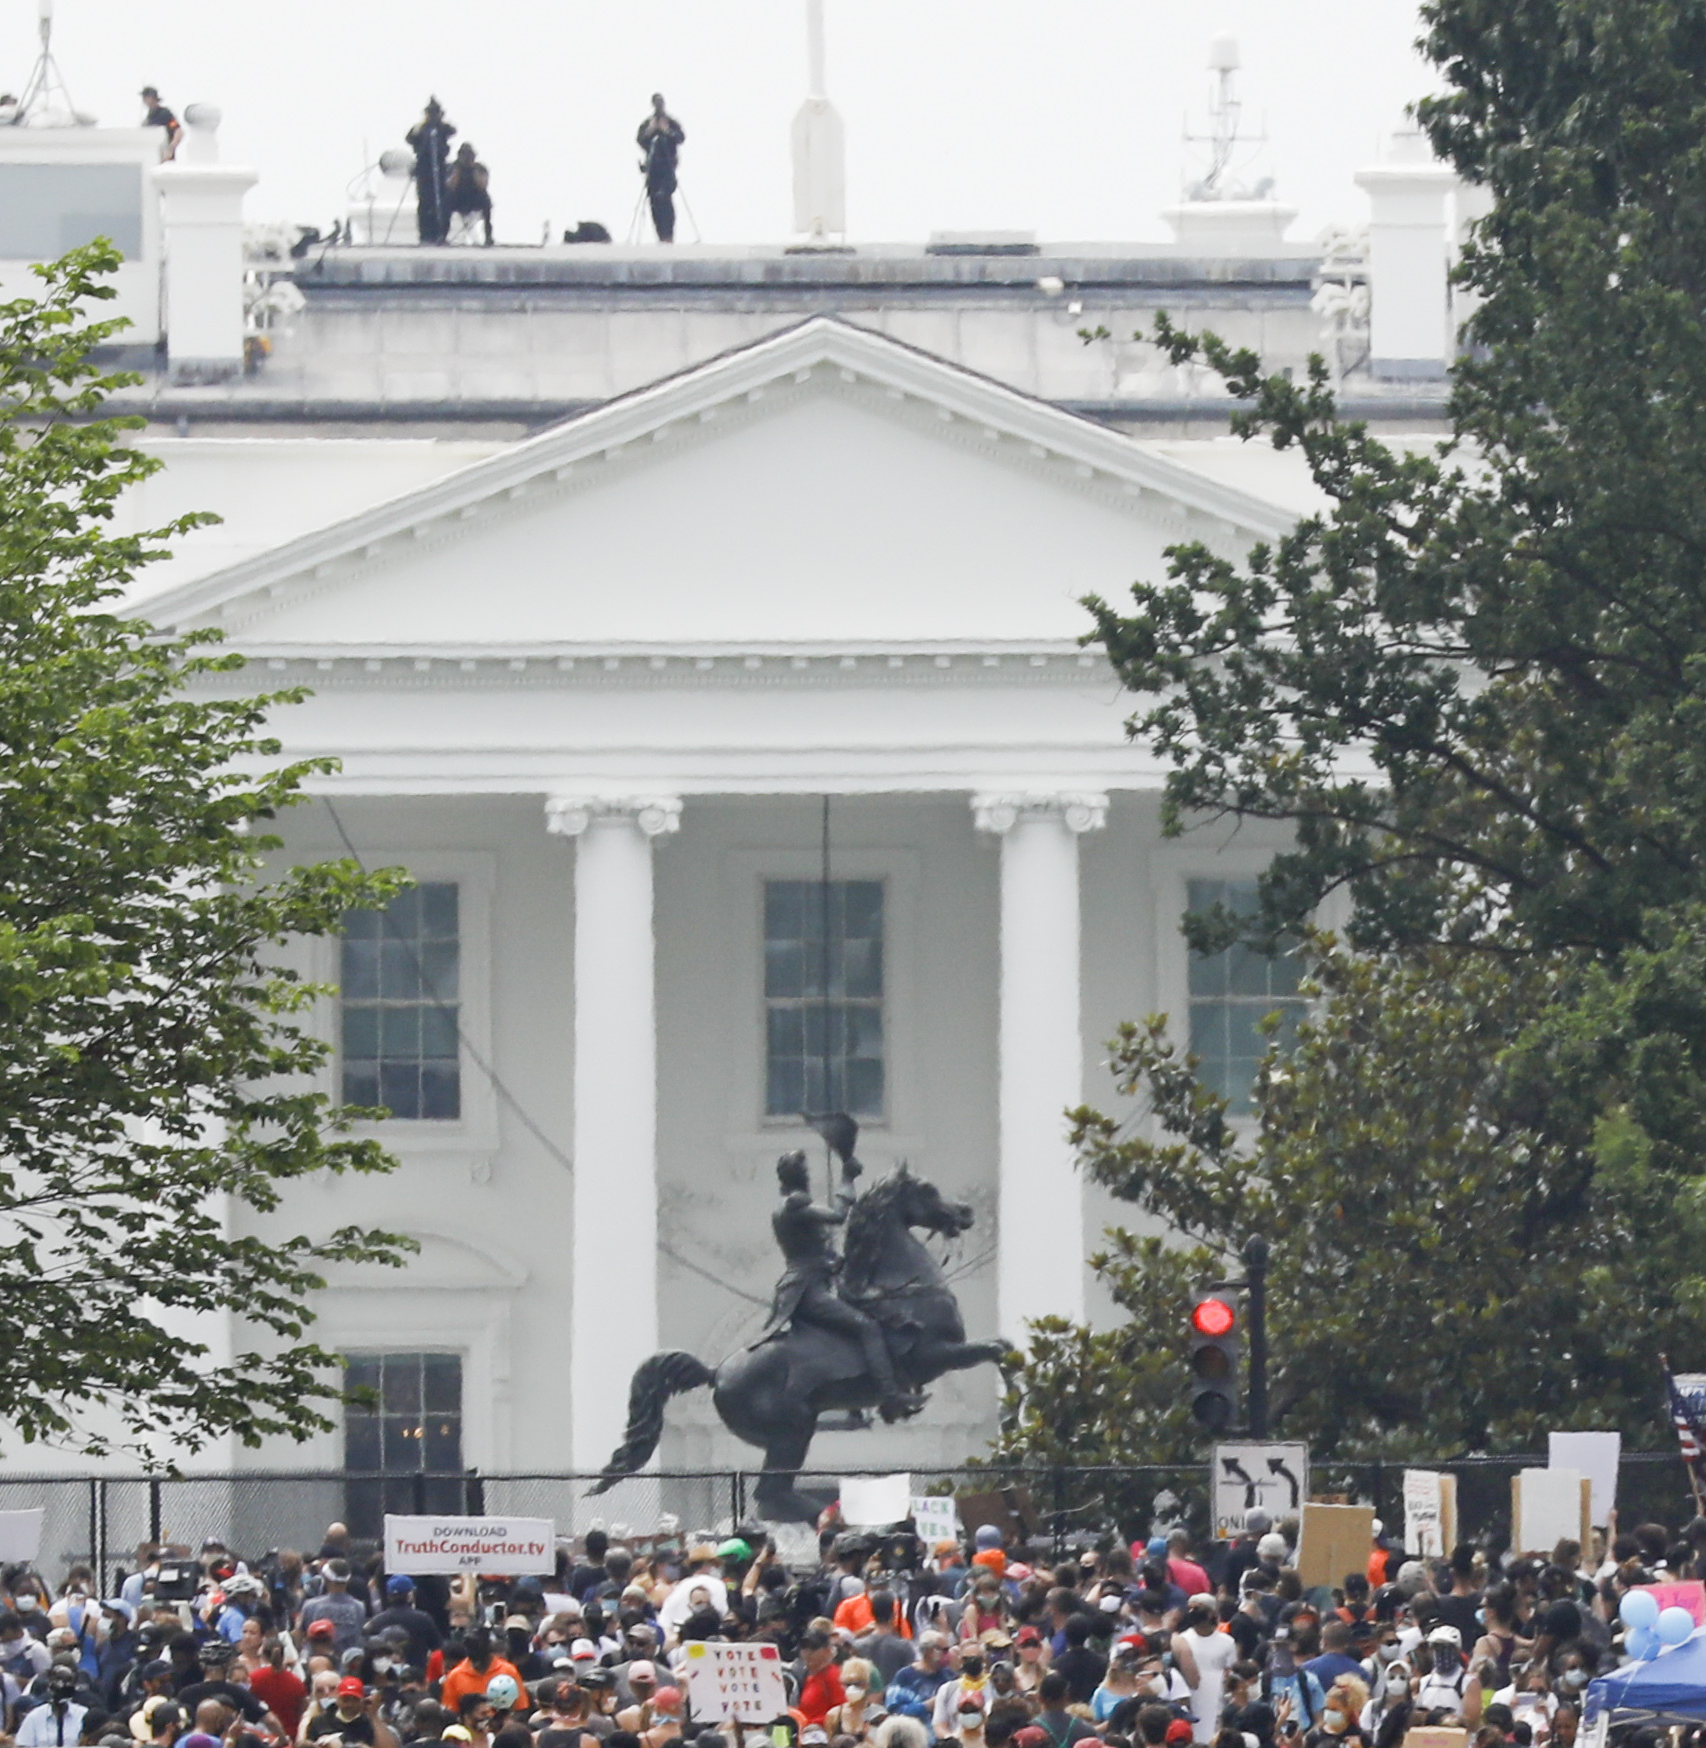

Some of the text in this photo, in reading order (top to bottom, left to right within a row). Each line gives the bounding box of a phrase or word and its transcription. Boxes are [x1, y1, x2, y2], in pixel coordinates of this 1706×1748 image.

[433, 1527, 508, 1537] DOWNLOAD
[396, 1540, 545, 1556] TruthConductor.tv
[458, 1557, 482, 1566] APP
[714, 1650, 756, 1661] VOTE
[718, 1666, 758, 1679] VOTE
[720, 1683, 760, 1693] VOTE
[722, 1701, 762, 1713] VOTE
